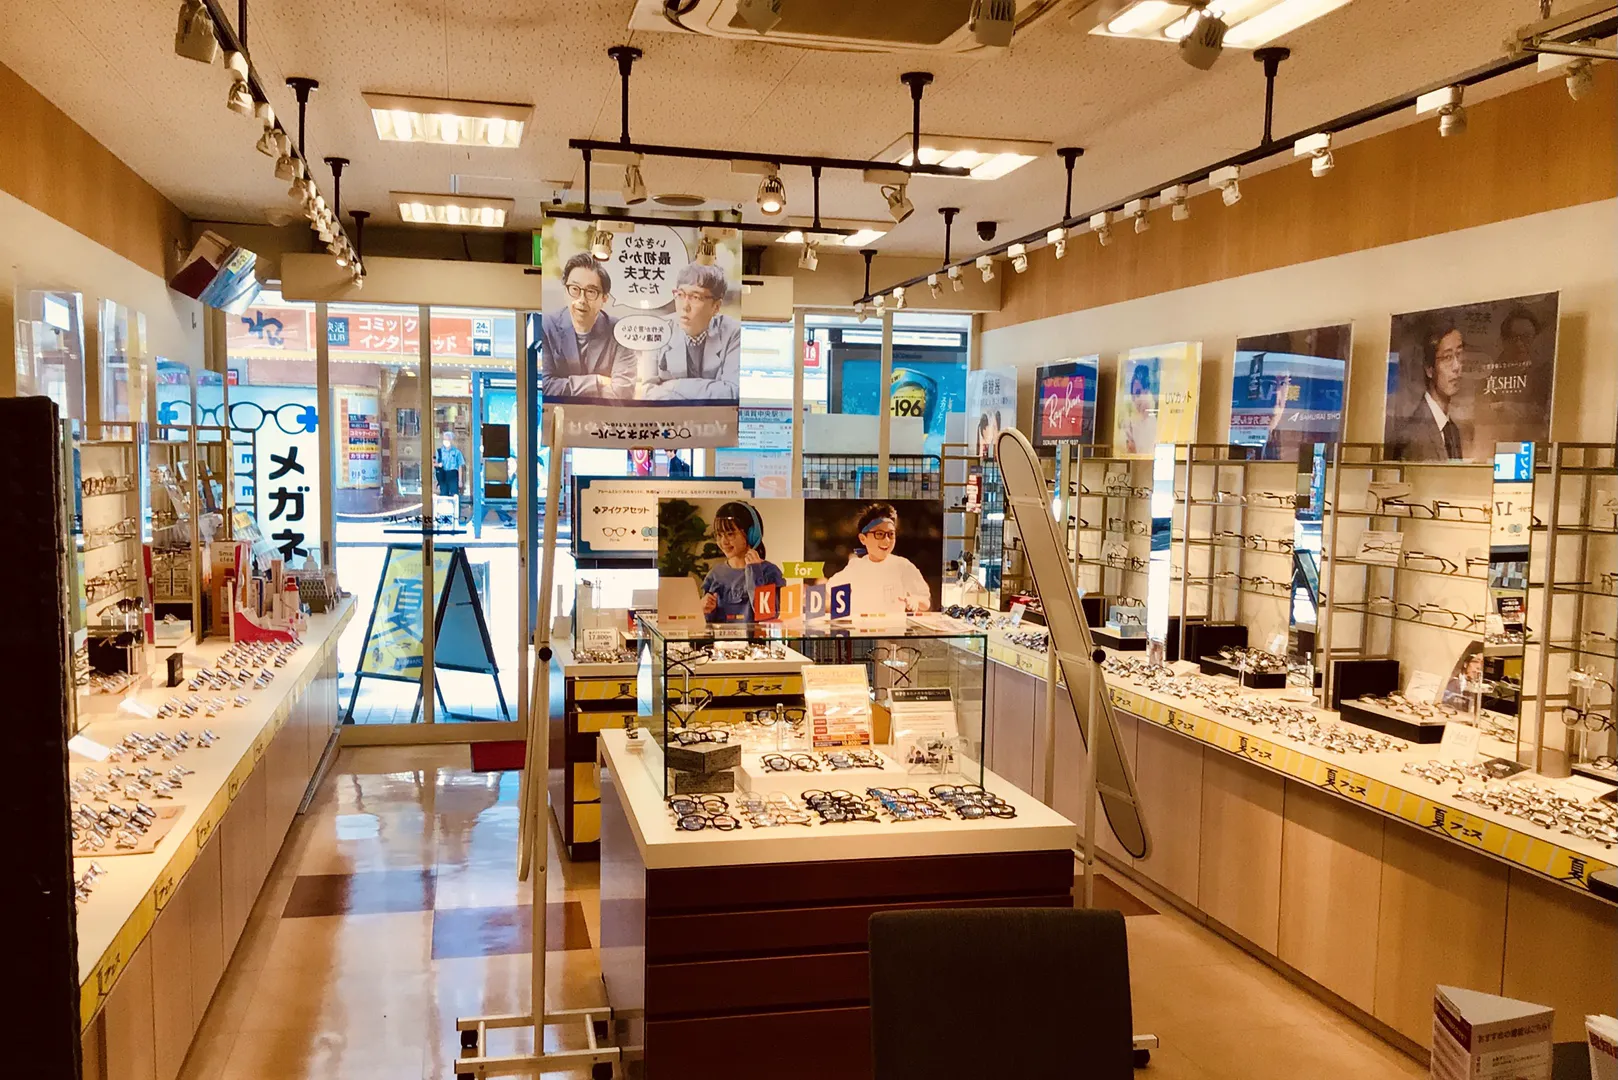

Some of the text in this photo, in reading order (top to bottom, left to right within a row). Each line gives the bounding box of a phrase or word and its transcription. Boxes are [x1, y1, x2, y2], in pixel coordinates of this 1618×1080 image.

[358, 316, 418, 333] コミック
[591, 429, 660, 440] メガネスーパー
[268, 446, 310, 563] メガネ
[601, 506, 650, 514] アイケアセット
[794, 564, 813, 576] for
[759, 590, 847, 614] KIDS
[731, 680, 782, 696] 夏フェス
[1165, 709, 1195, 733] 夏フェス
[1233, 735, 1272, 760] 夏フェス
[1320, 767, 1367, 797] 夏フェス
[1424, 806, 1483, 842] 夏フェス
